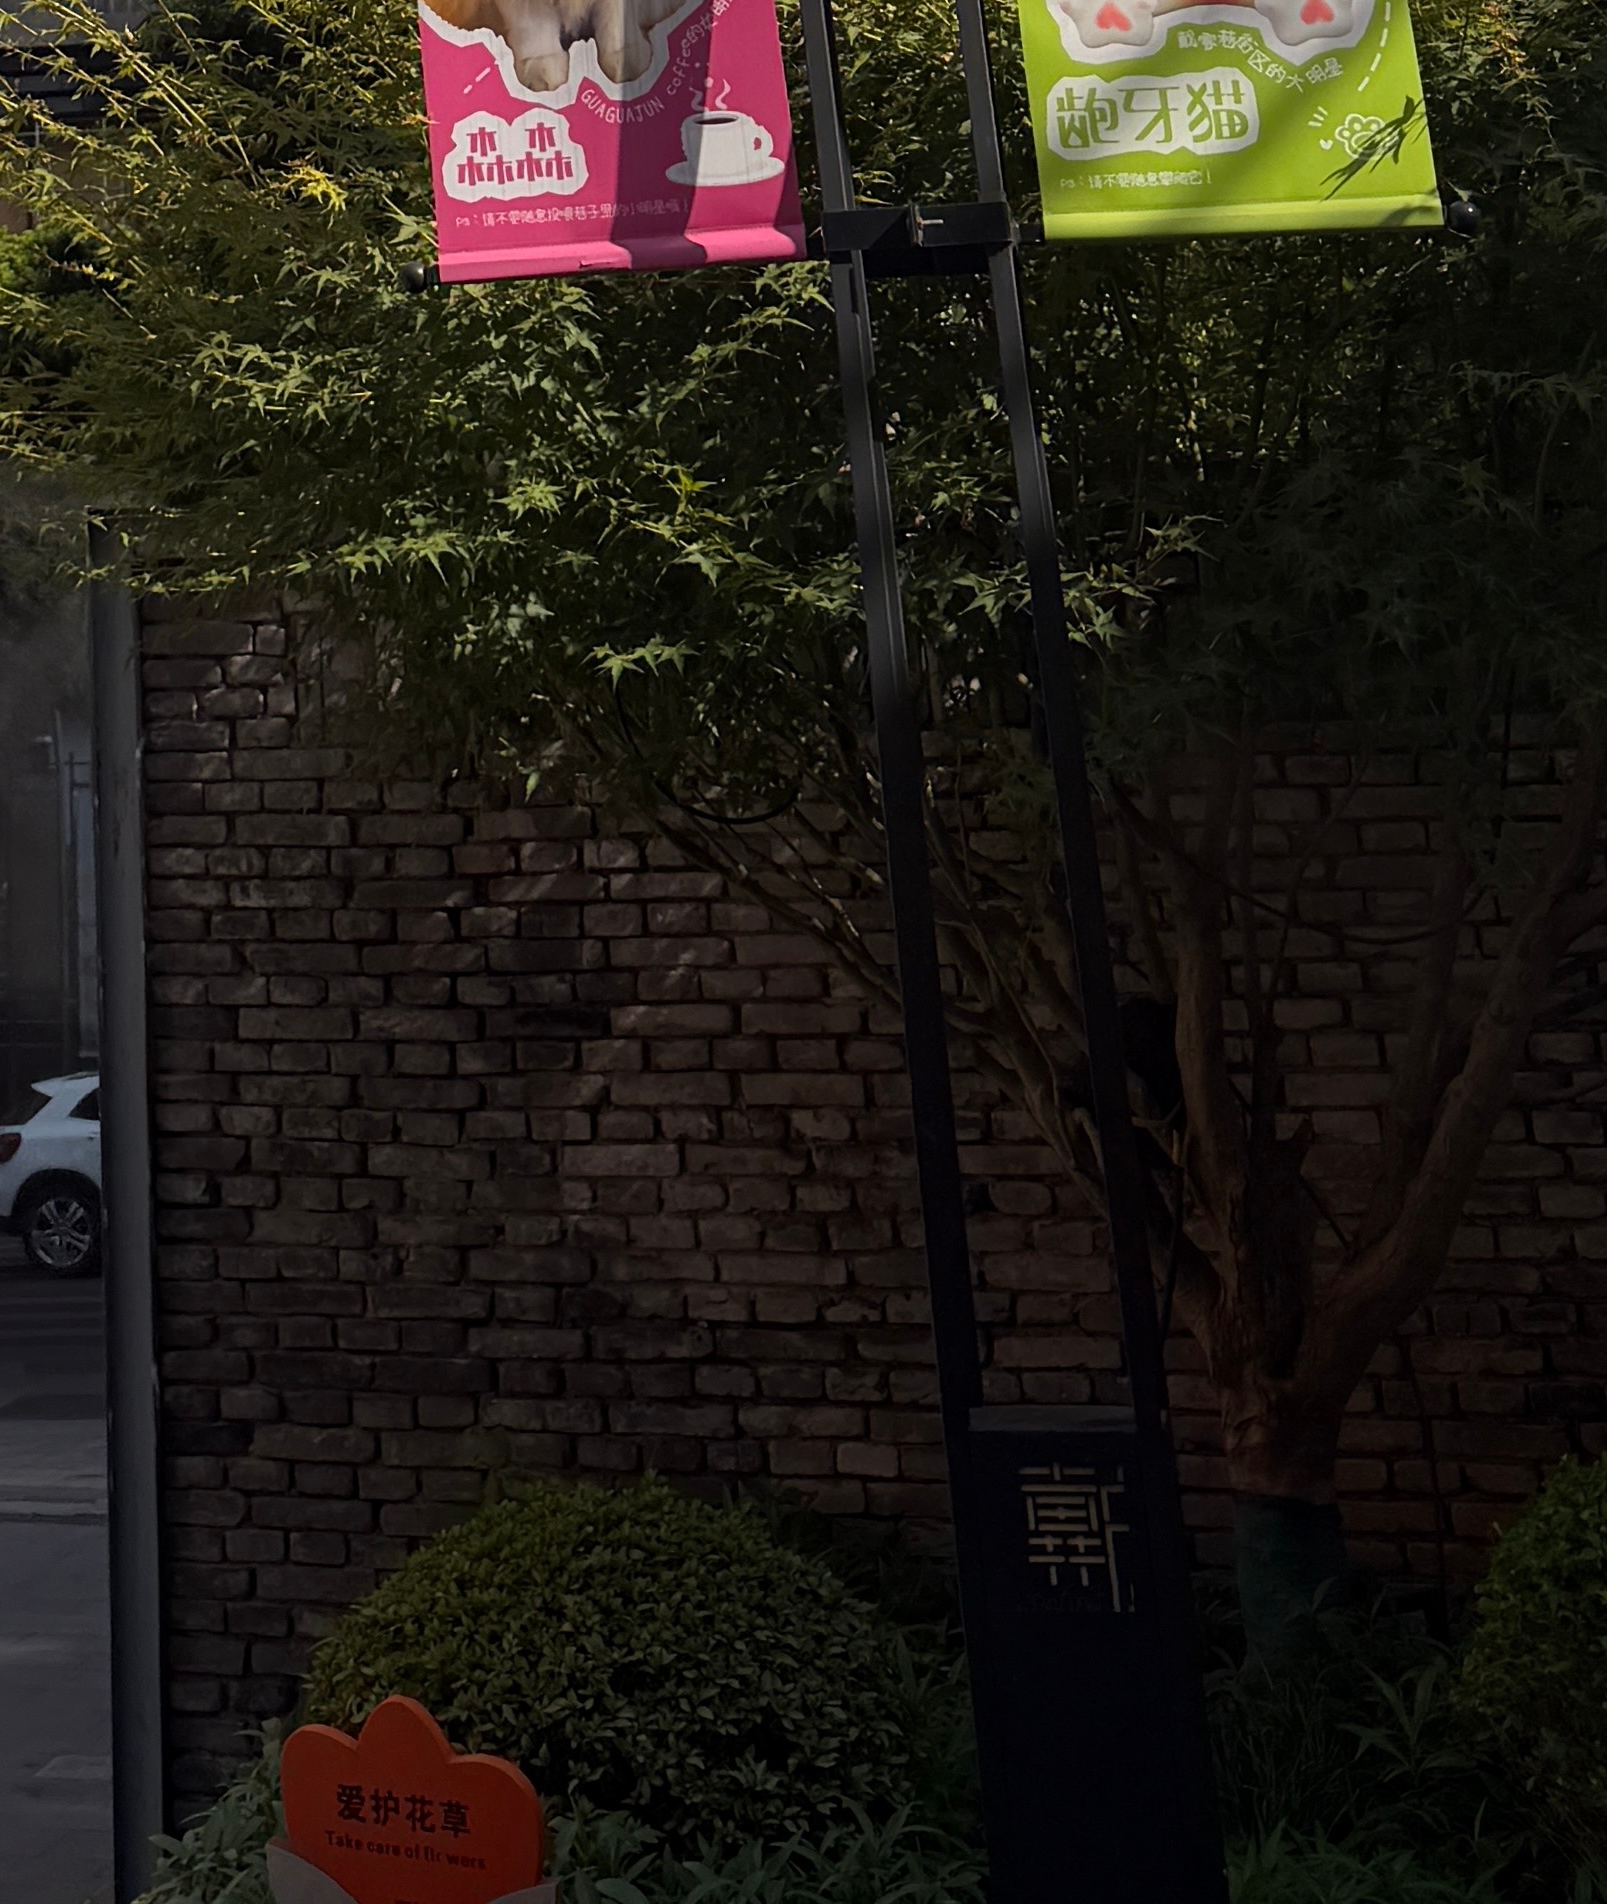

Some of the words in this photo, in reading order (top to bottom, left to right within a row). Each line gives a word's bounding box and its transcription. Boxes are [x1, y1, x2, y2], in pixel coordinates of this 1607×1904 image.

[580, 88, 666, 125] GUAGUAJUN
[1055, 79, 1250, 149] 龅牙猫
[335, 1783, 472, 1839] 爱护花草
[325, 1829, 364, 1852] Take
[366, 1841, 402, 1859] care
[404, 1845, 421, 1861] of
